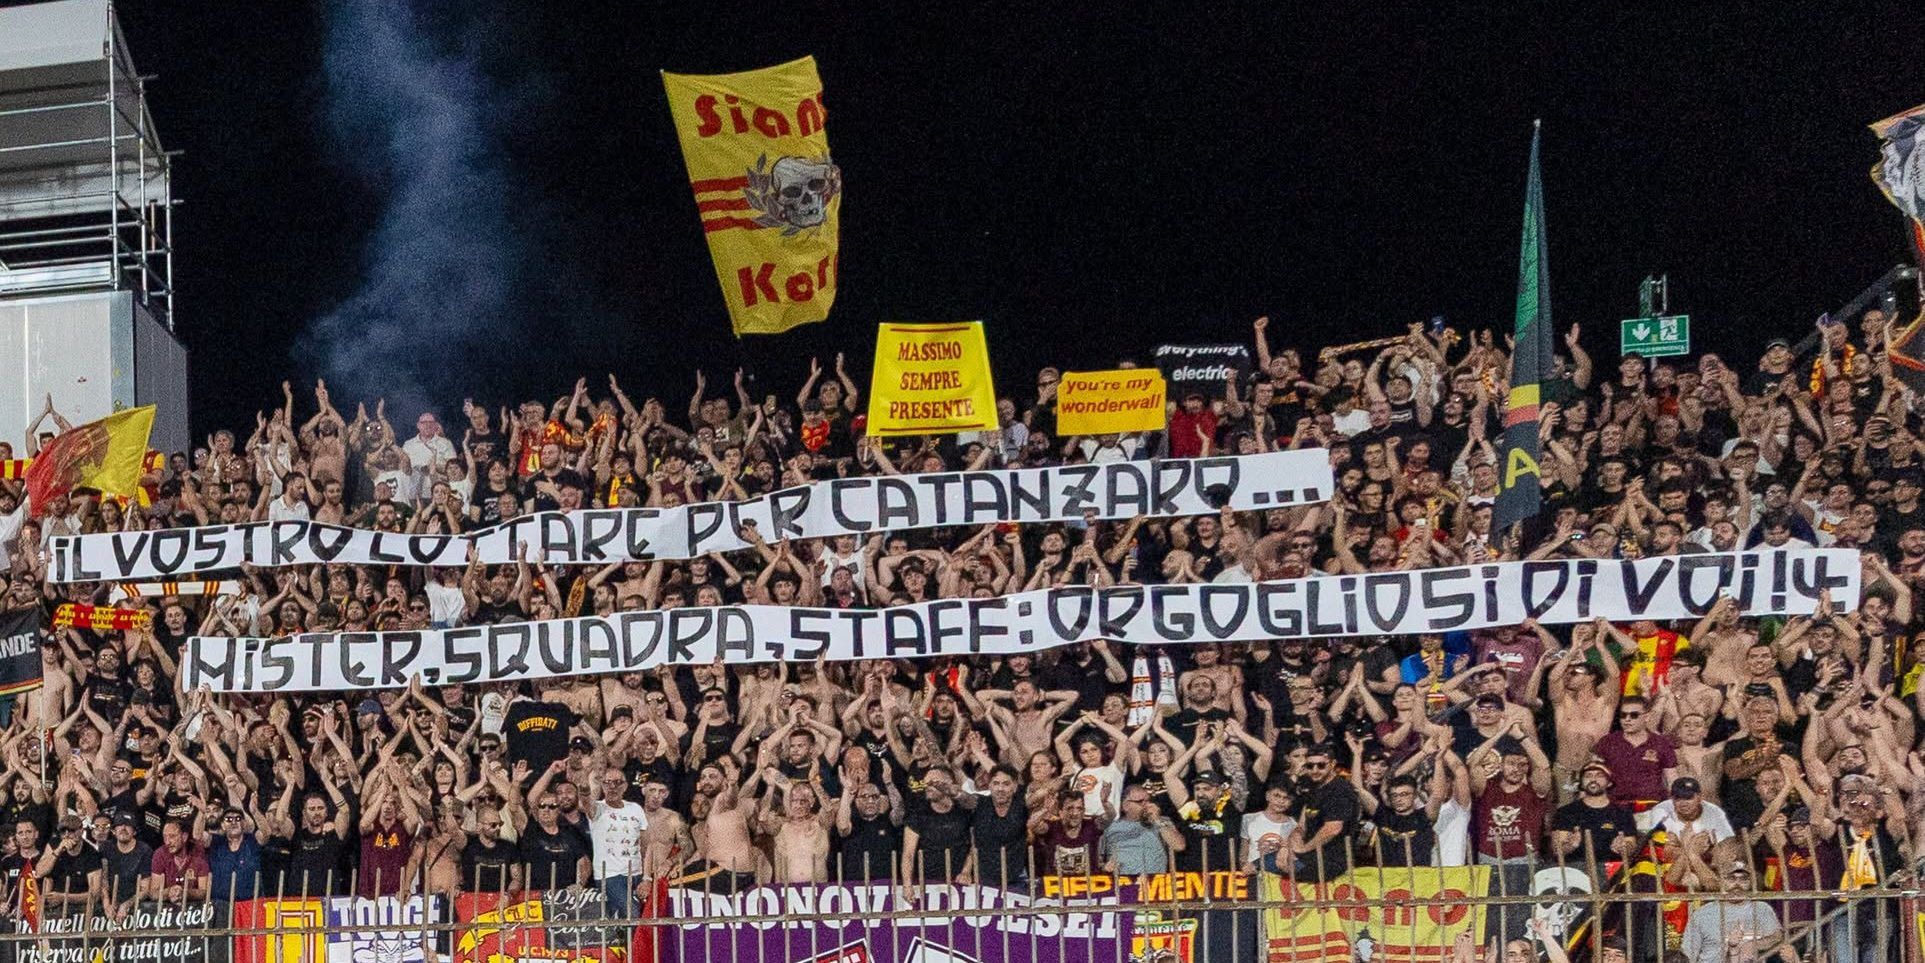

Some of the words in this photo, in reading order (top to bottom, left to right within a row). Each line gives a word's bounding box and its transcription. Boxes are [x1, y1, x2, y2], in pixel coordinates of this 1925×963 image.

[898, 341, 962, 361] MASSIMO
[900, 370, 962, 390] SEMPRE
[1172, 364, 1238, 381] electric
[1067, 379, 1121, 394] you're
[1126, 378, 1153, 391] my
[889, 398, 975, 419] PRESENTE
[1061, 394, 1161, 414] wonderwall
[112, 519, 353, 577] VOSTRO
[368, 509, 660, 564] LOTTARE
[687, 484, 812, 557] PER
[0, 632, 36, 660] NDE
